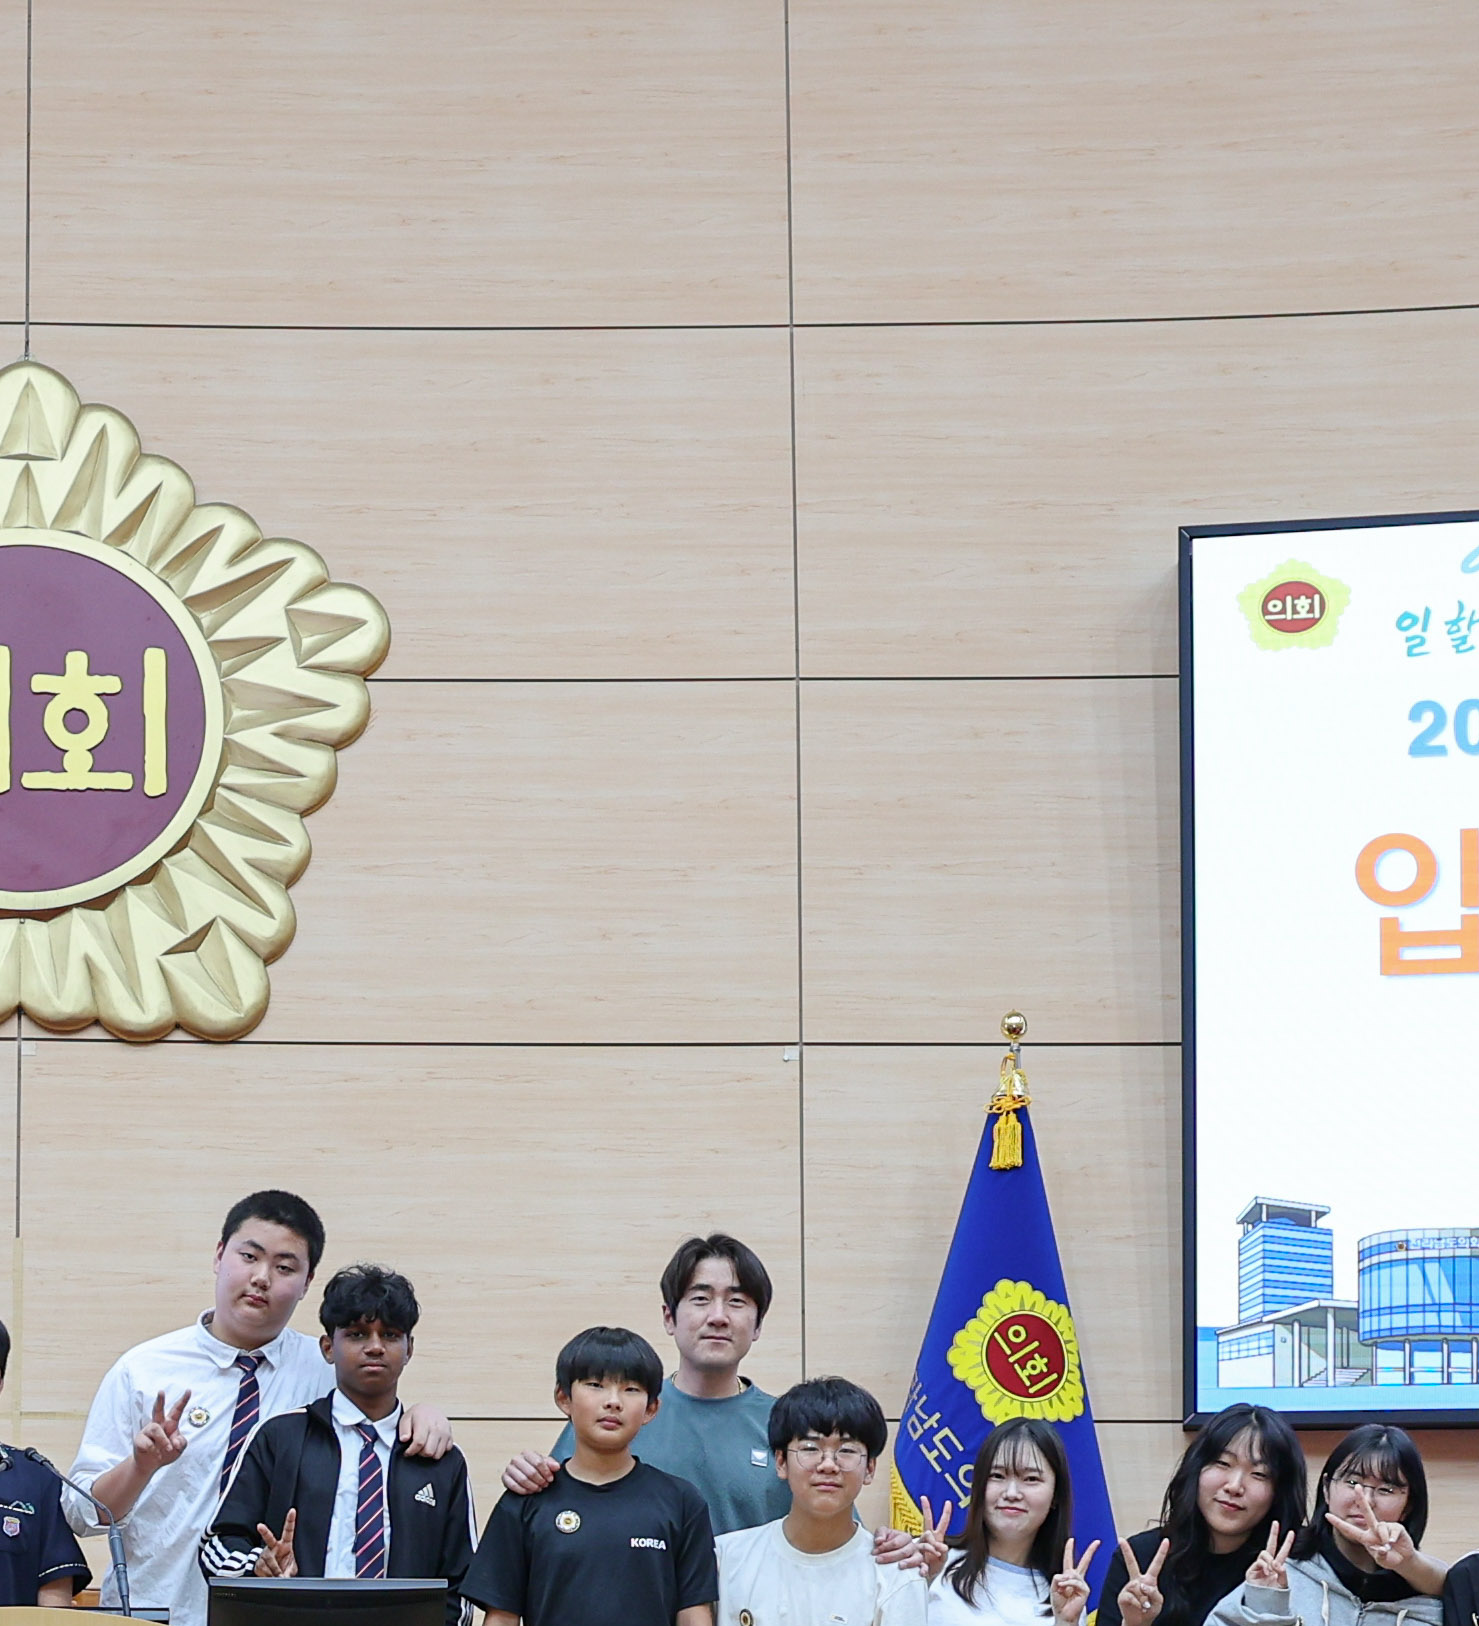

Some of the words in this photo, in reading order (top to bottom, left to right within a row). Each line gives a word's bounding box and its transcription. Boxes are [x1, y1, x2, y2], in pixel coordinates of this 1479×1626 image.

[1264, 592, 1322, 625] 의회
[994, 1322, 1058, 1395] 의회
[630, 1537, 667, 1550] KOREA
